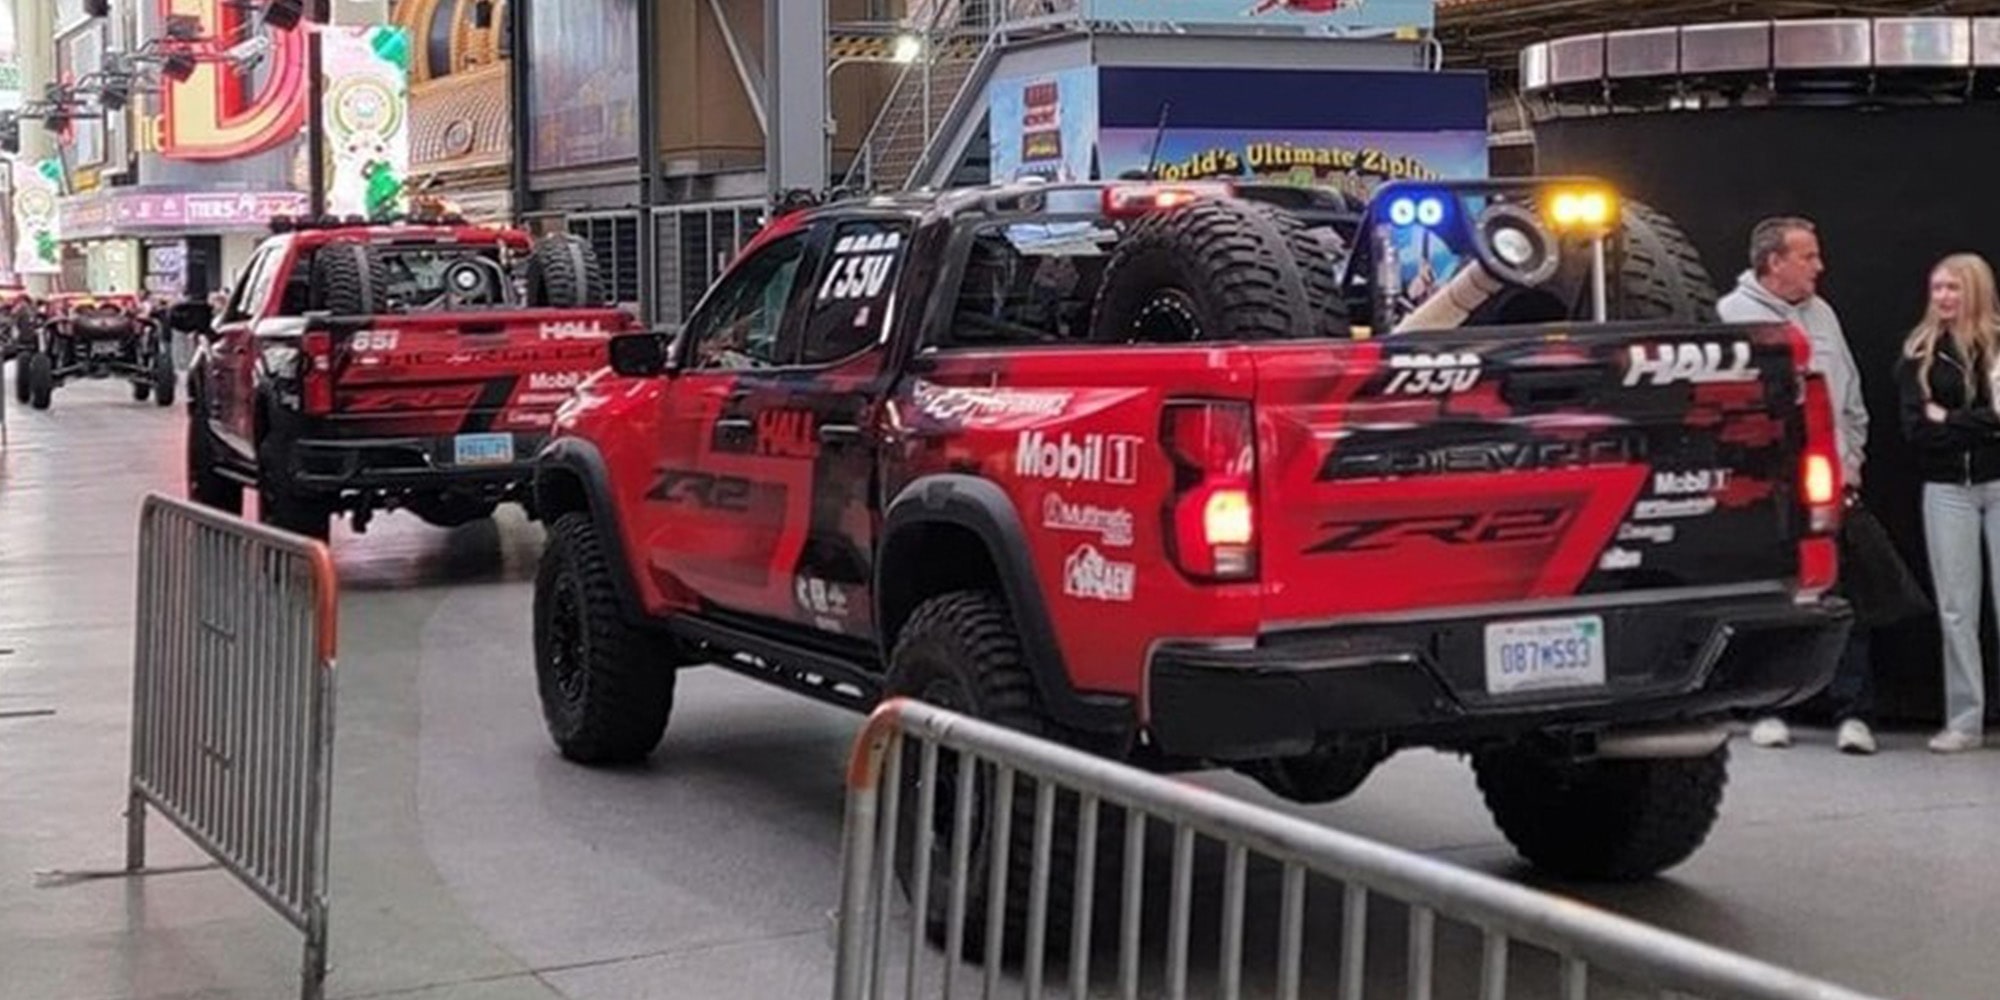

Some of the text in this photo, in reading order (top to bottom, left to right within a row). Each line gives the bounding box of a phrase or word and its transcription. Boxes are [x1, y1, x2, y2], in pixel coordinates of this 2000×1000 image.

[1247, 143, 1355, 167] Ultimate
[540, 320, 612, 340] HALL
[1622, 341, 1760, 386] HALL
[1016, 430, 1102, 481] Mobil
[1655, 471, 1709, 494] Mobil
[1302, 508, 1574, 554] ZR2
